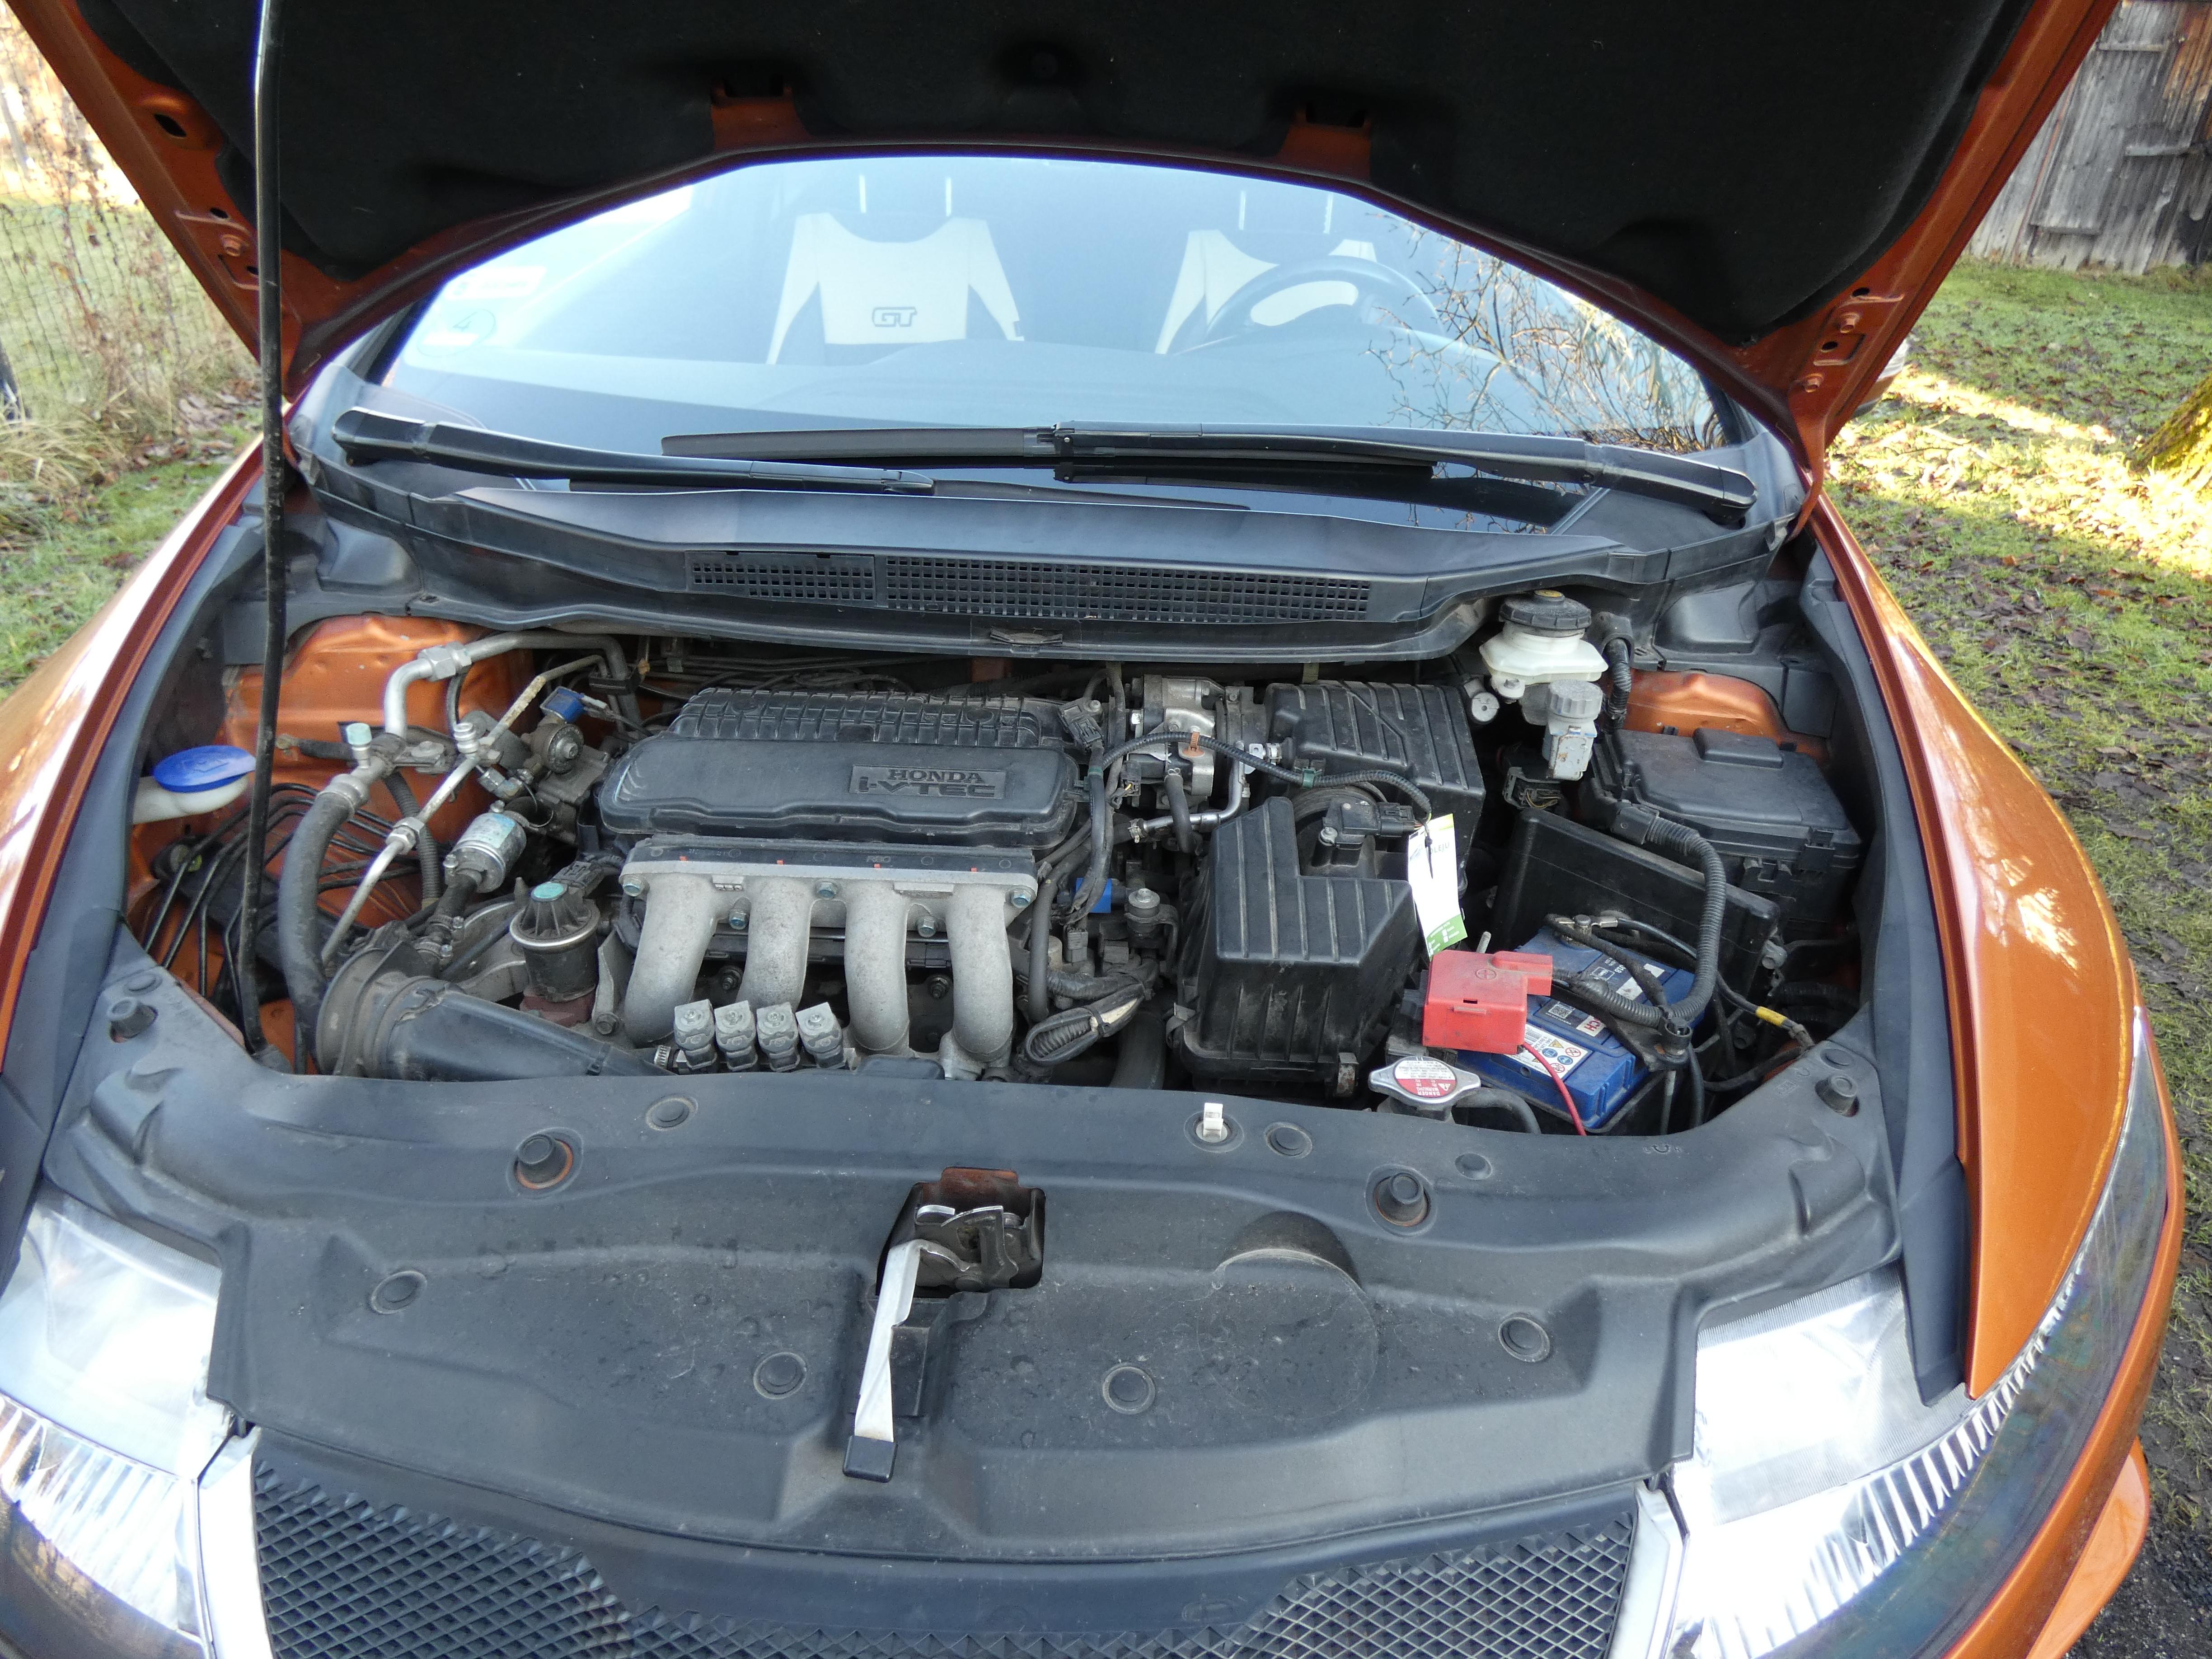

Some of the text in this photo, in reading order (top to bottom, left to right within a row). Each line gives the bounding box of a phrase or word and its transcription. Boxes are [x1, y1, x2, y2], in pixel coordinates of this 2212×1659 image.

[453, 312, 477, 331] 4
[872, 307, 917, 327] GT
[888, 769, 984, 783] HONDA
[858, 776, 995, 797] i-VTEC
